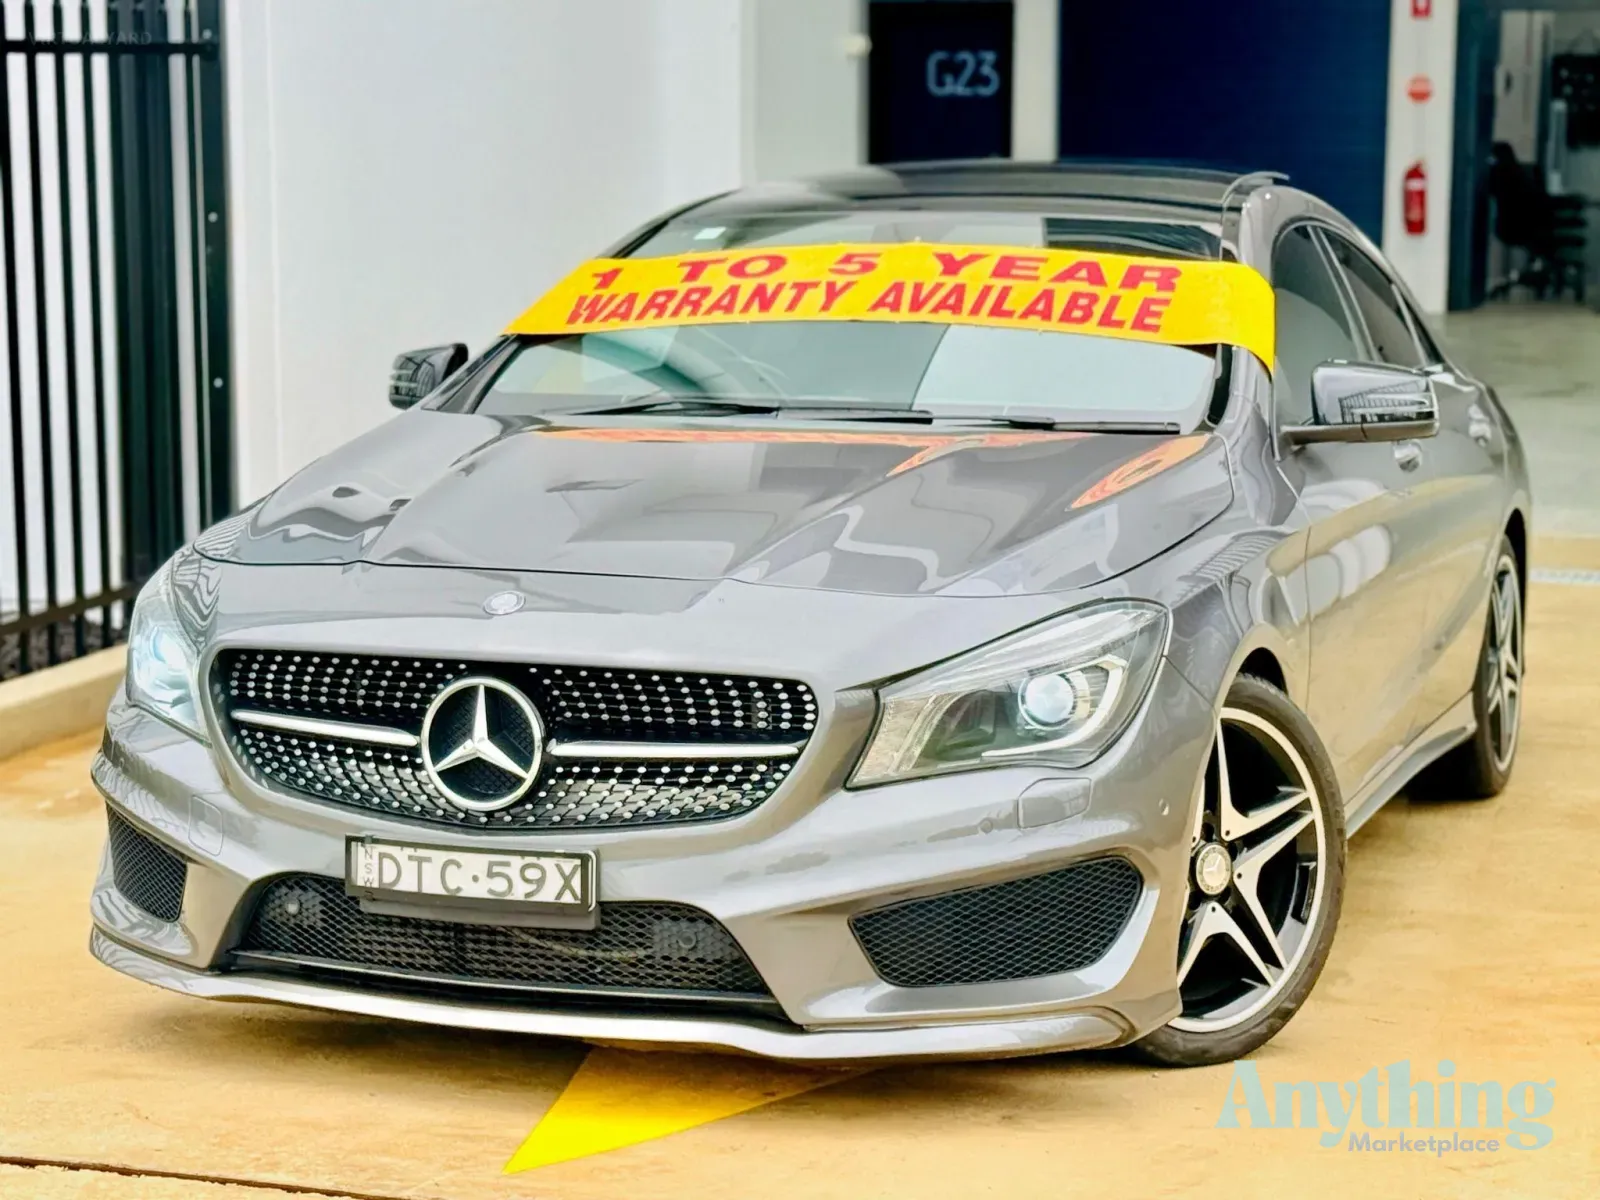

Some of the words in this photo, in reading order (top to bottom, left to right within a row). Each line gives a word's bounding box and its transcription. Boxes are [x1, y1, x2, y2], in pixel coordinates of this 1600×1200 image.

[926, 50, 999, 97] G23
[592, 268, 623, 289] 1
[677, 255, 787, 283] TO
[828, 253, 882, 275] 5
[933, 252, 1183, 293] YEAR
[565, 281, 857, 325] WARRANTY
[867, 280, 1173, 333] AVAILABLE
